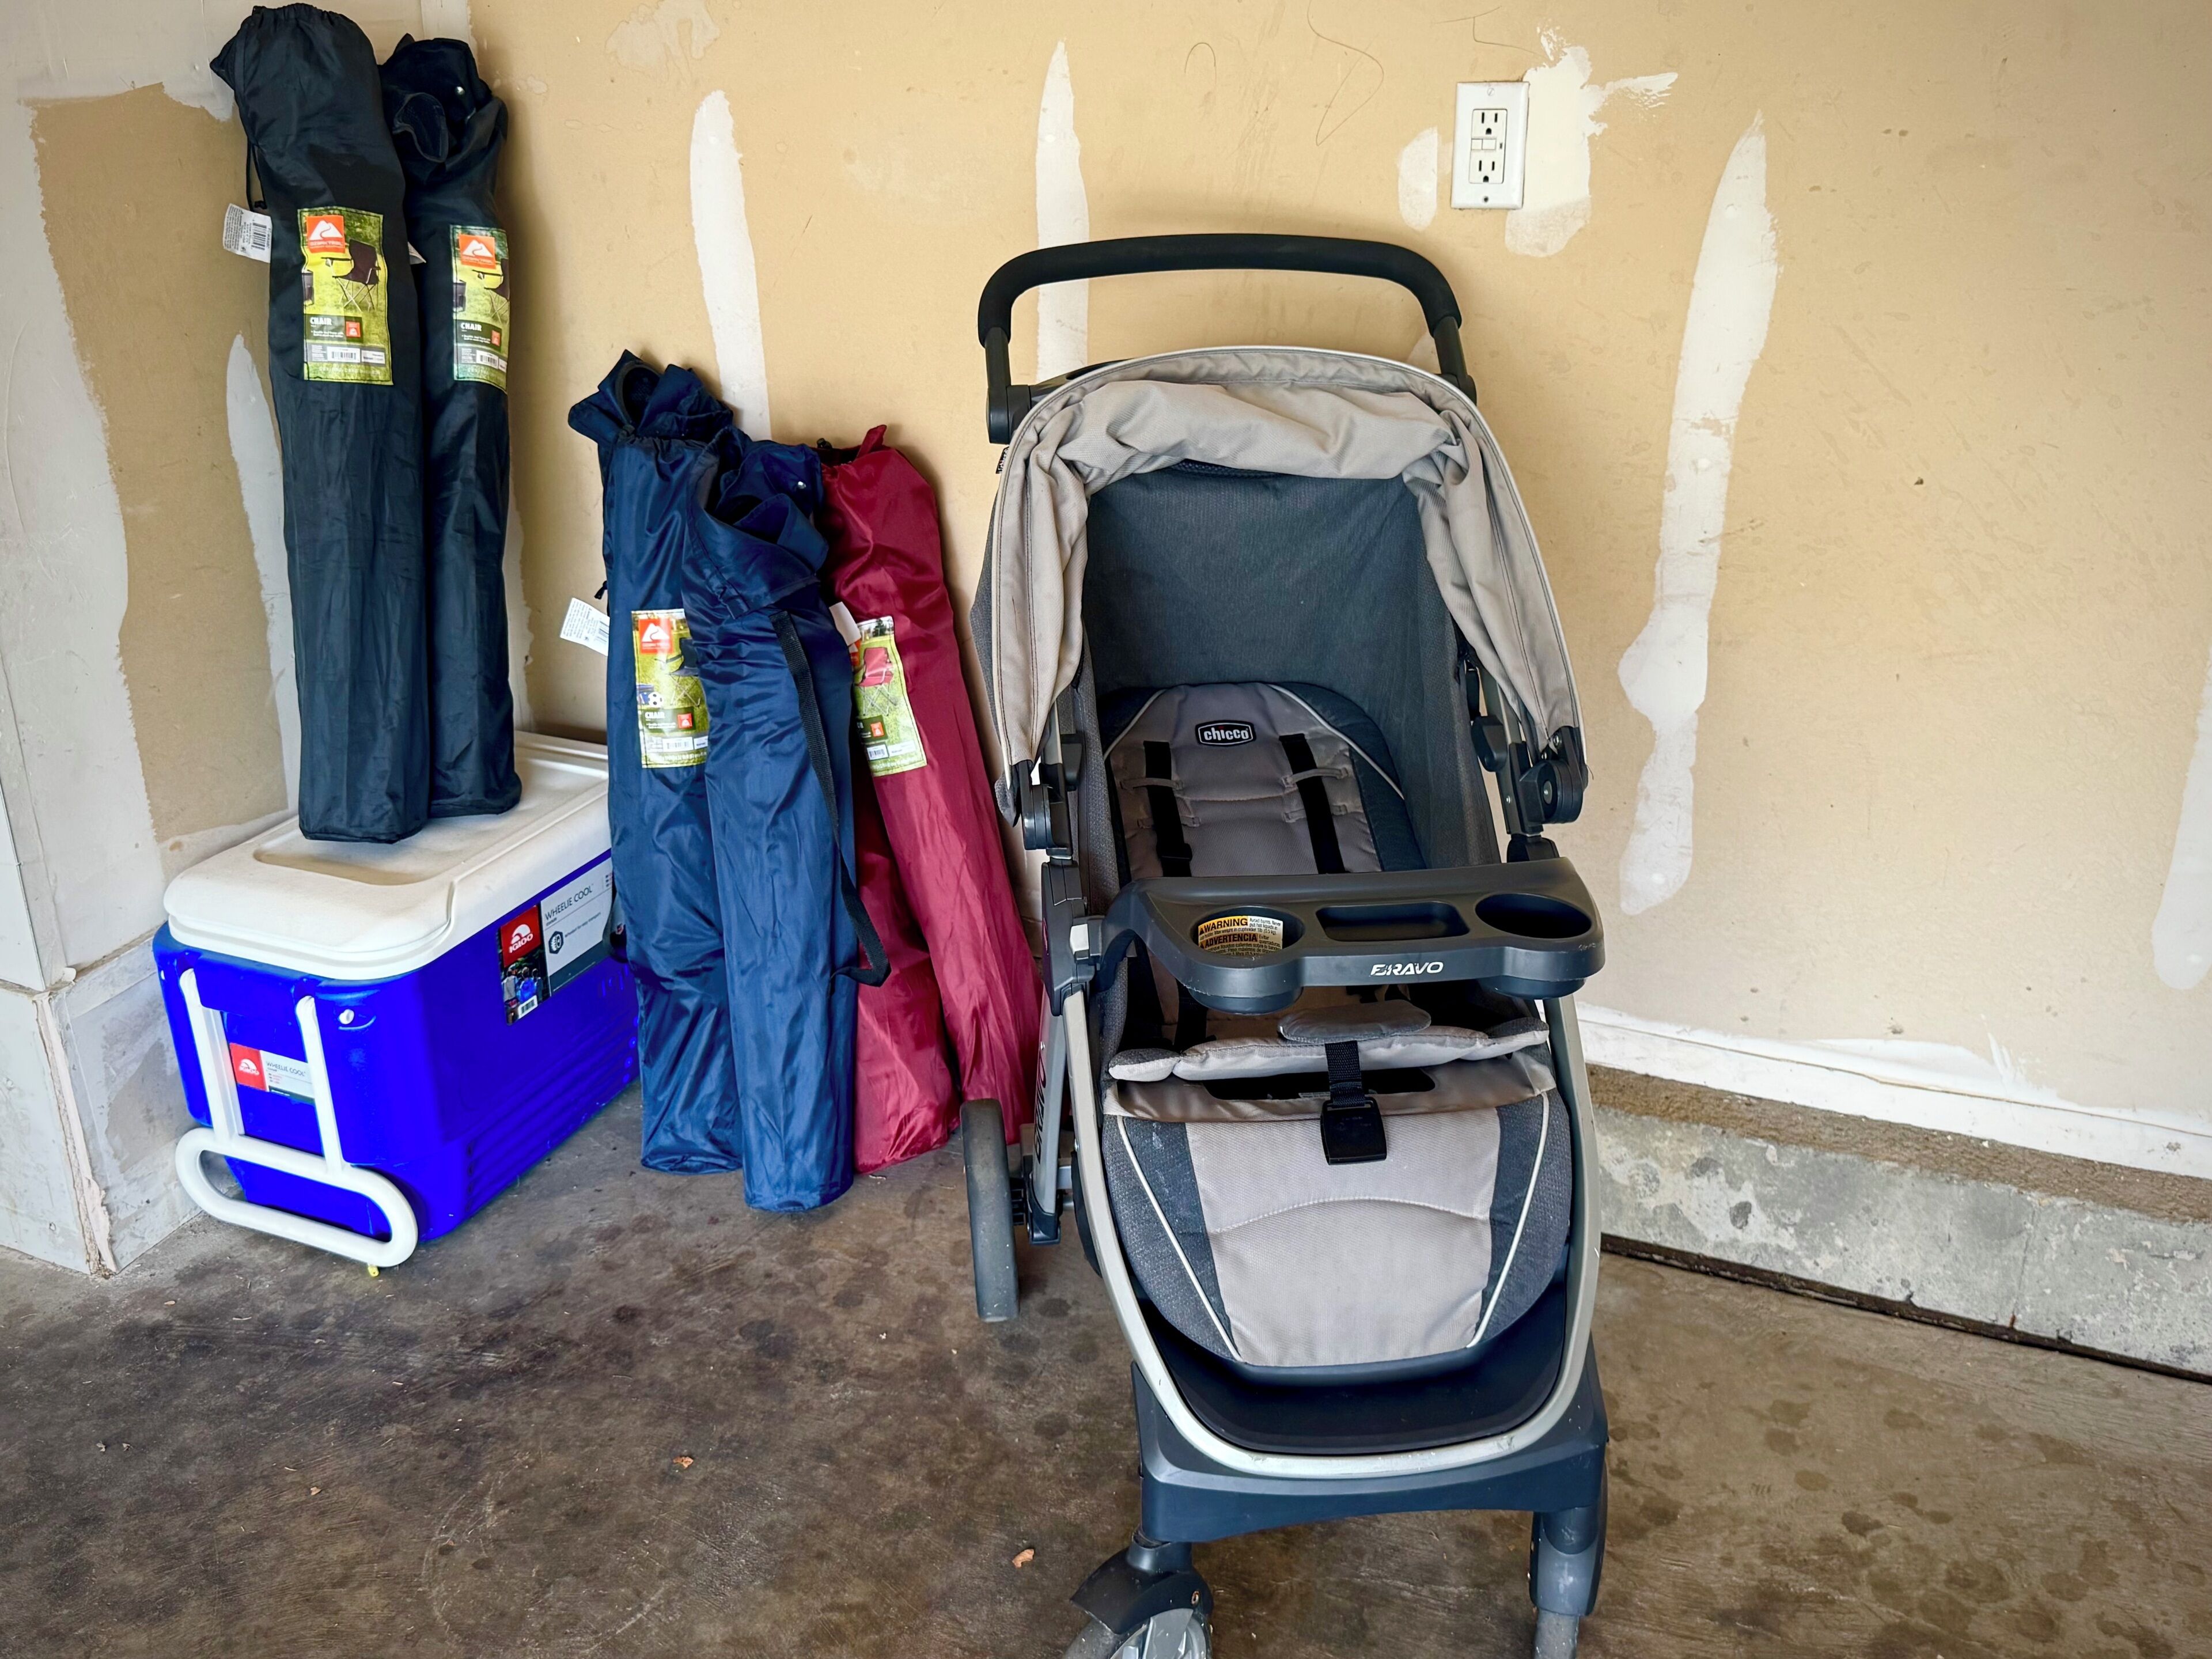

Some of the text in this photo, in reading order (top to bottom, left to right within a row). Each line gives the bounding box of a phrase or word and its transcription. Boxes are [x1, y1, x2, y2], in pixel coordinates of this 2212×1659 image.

[310, 317, 332, 325] CHAIR
[460, 323, 482, 331] CHAIR
[1203, 726, 1249, 741] chicco
[545, 885, 592, 921] WHEELIE COOL
[1204, 918, 1248, 933] WARNING
[509, 933, 533, 953] IGLOO
[1205, 933, 1258, 949] ADVERTENCIA
[1370, 961, 1444, 976] BRAVO
